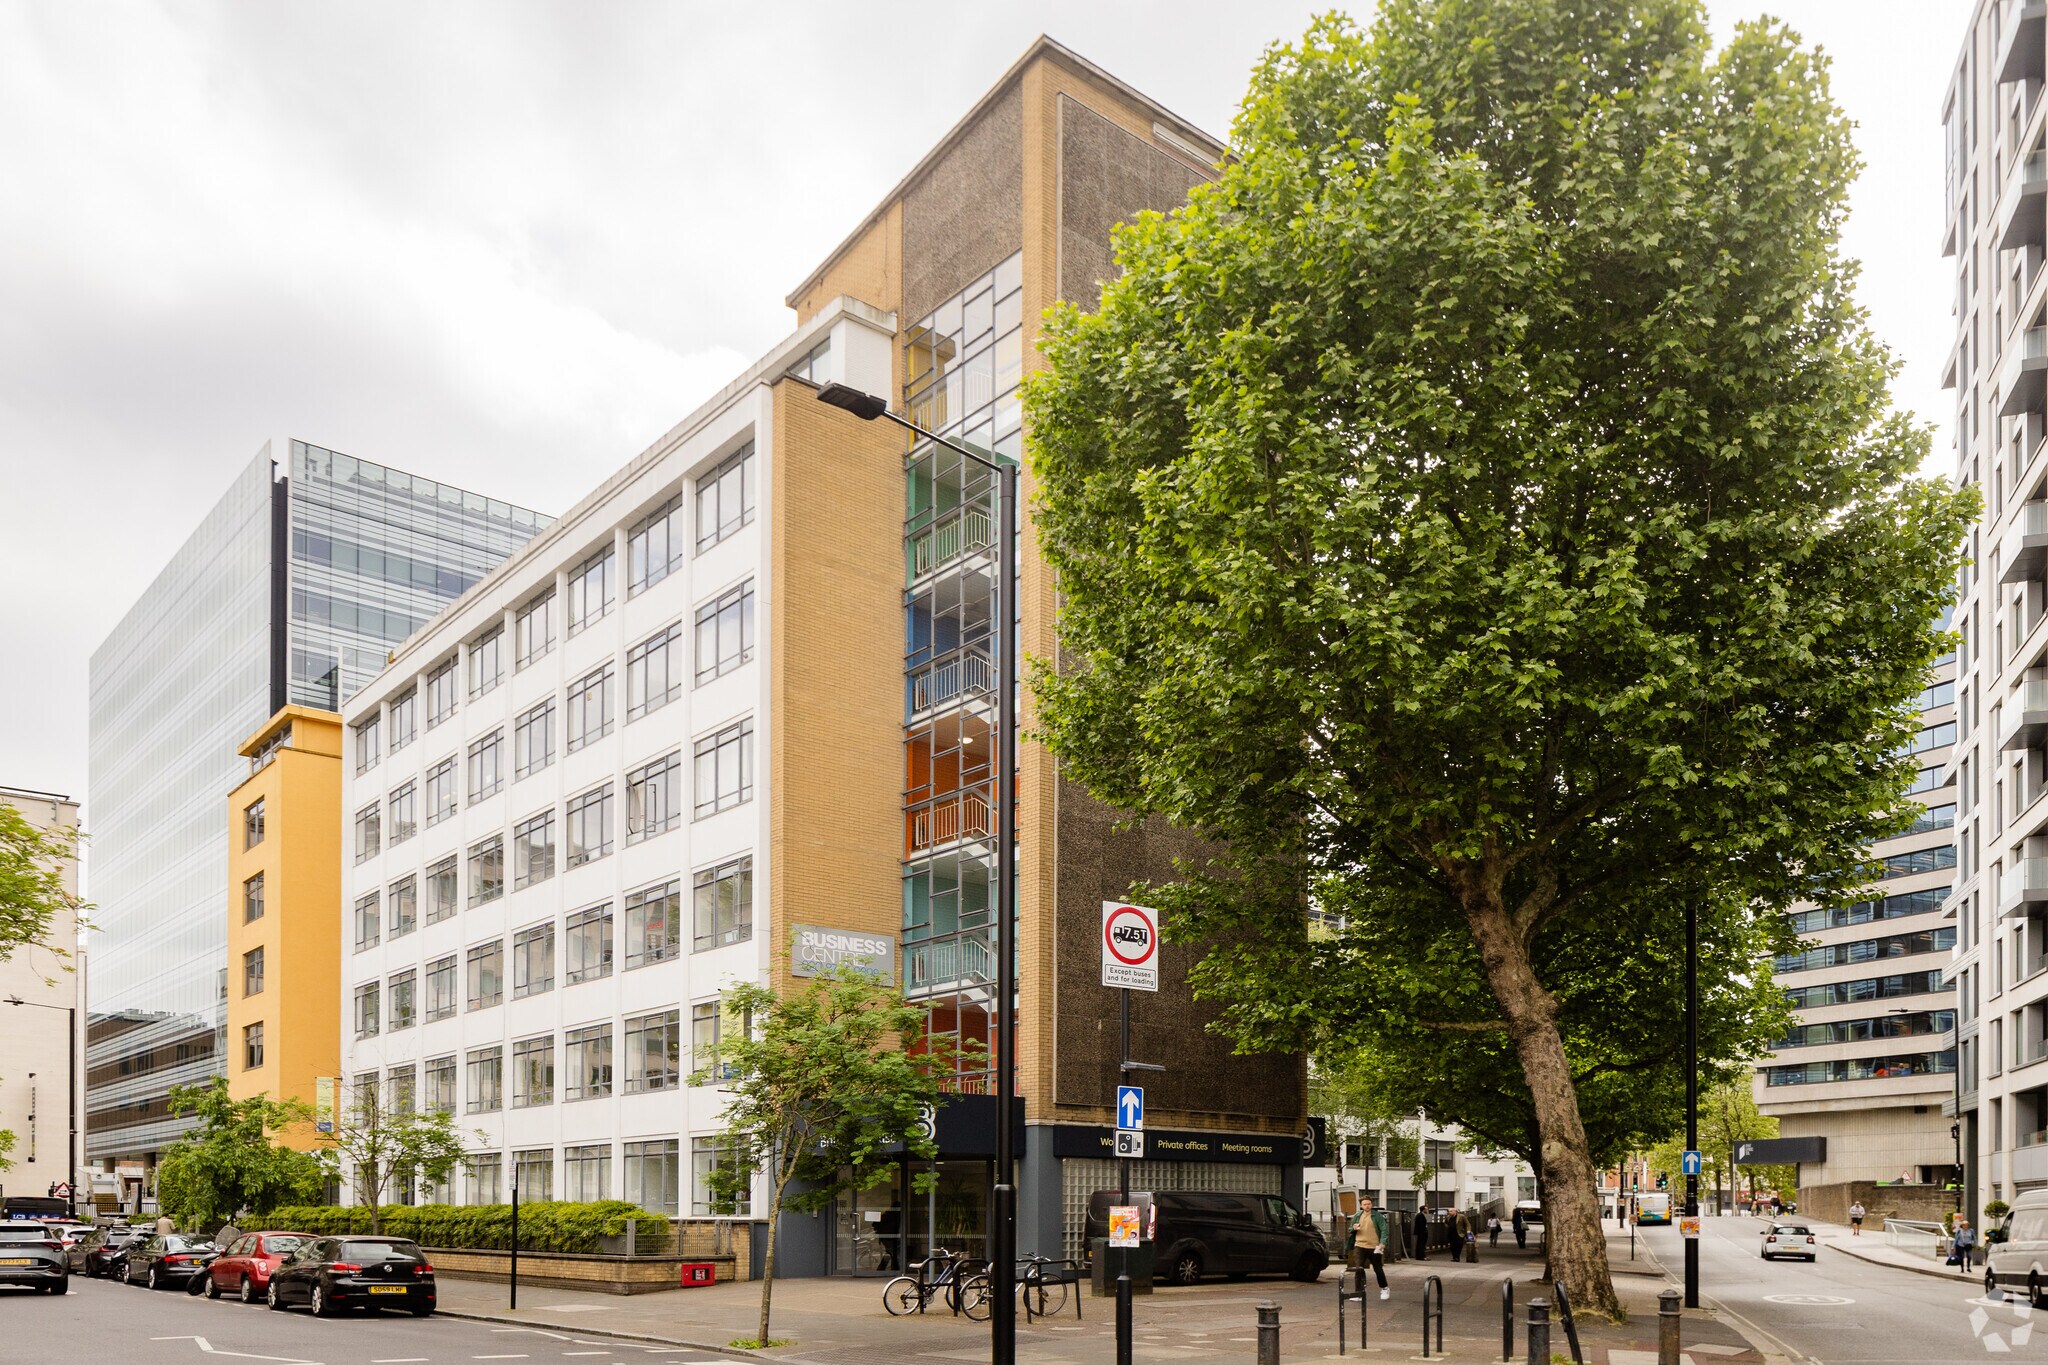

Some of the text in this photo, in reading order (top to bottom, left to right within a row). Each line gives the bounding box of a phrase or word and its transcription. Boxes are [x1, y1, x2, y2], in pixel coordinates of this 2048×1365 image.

[1124, 927, 1147, 940] 7.5T
[801, 931, 887, 956] BUSINESS
[801, 945, 866, 968] CENTRE
[1109, 967, 1131, 976] Except
[1132, 976, 1154, 987] loading
[1158, 1140, 1208, 1151] Private offices
[1222, 1143, 1273, 1154] Meeting rooms
